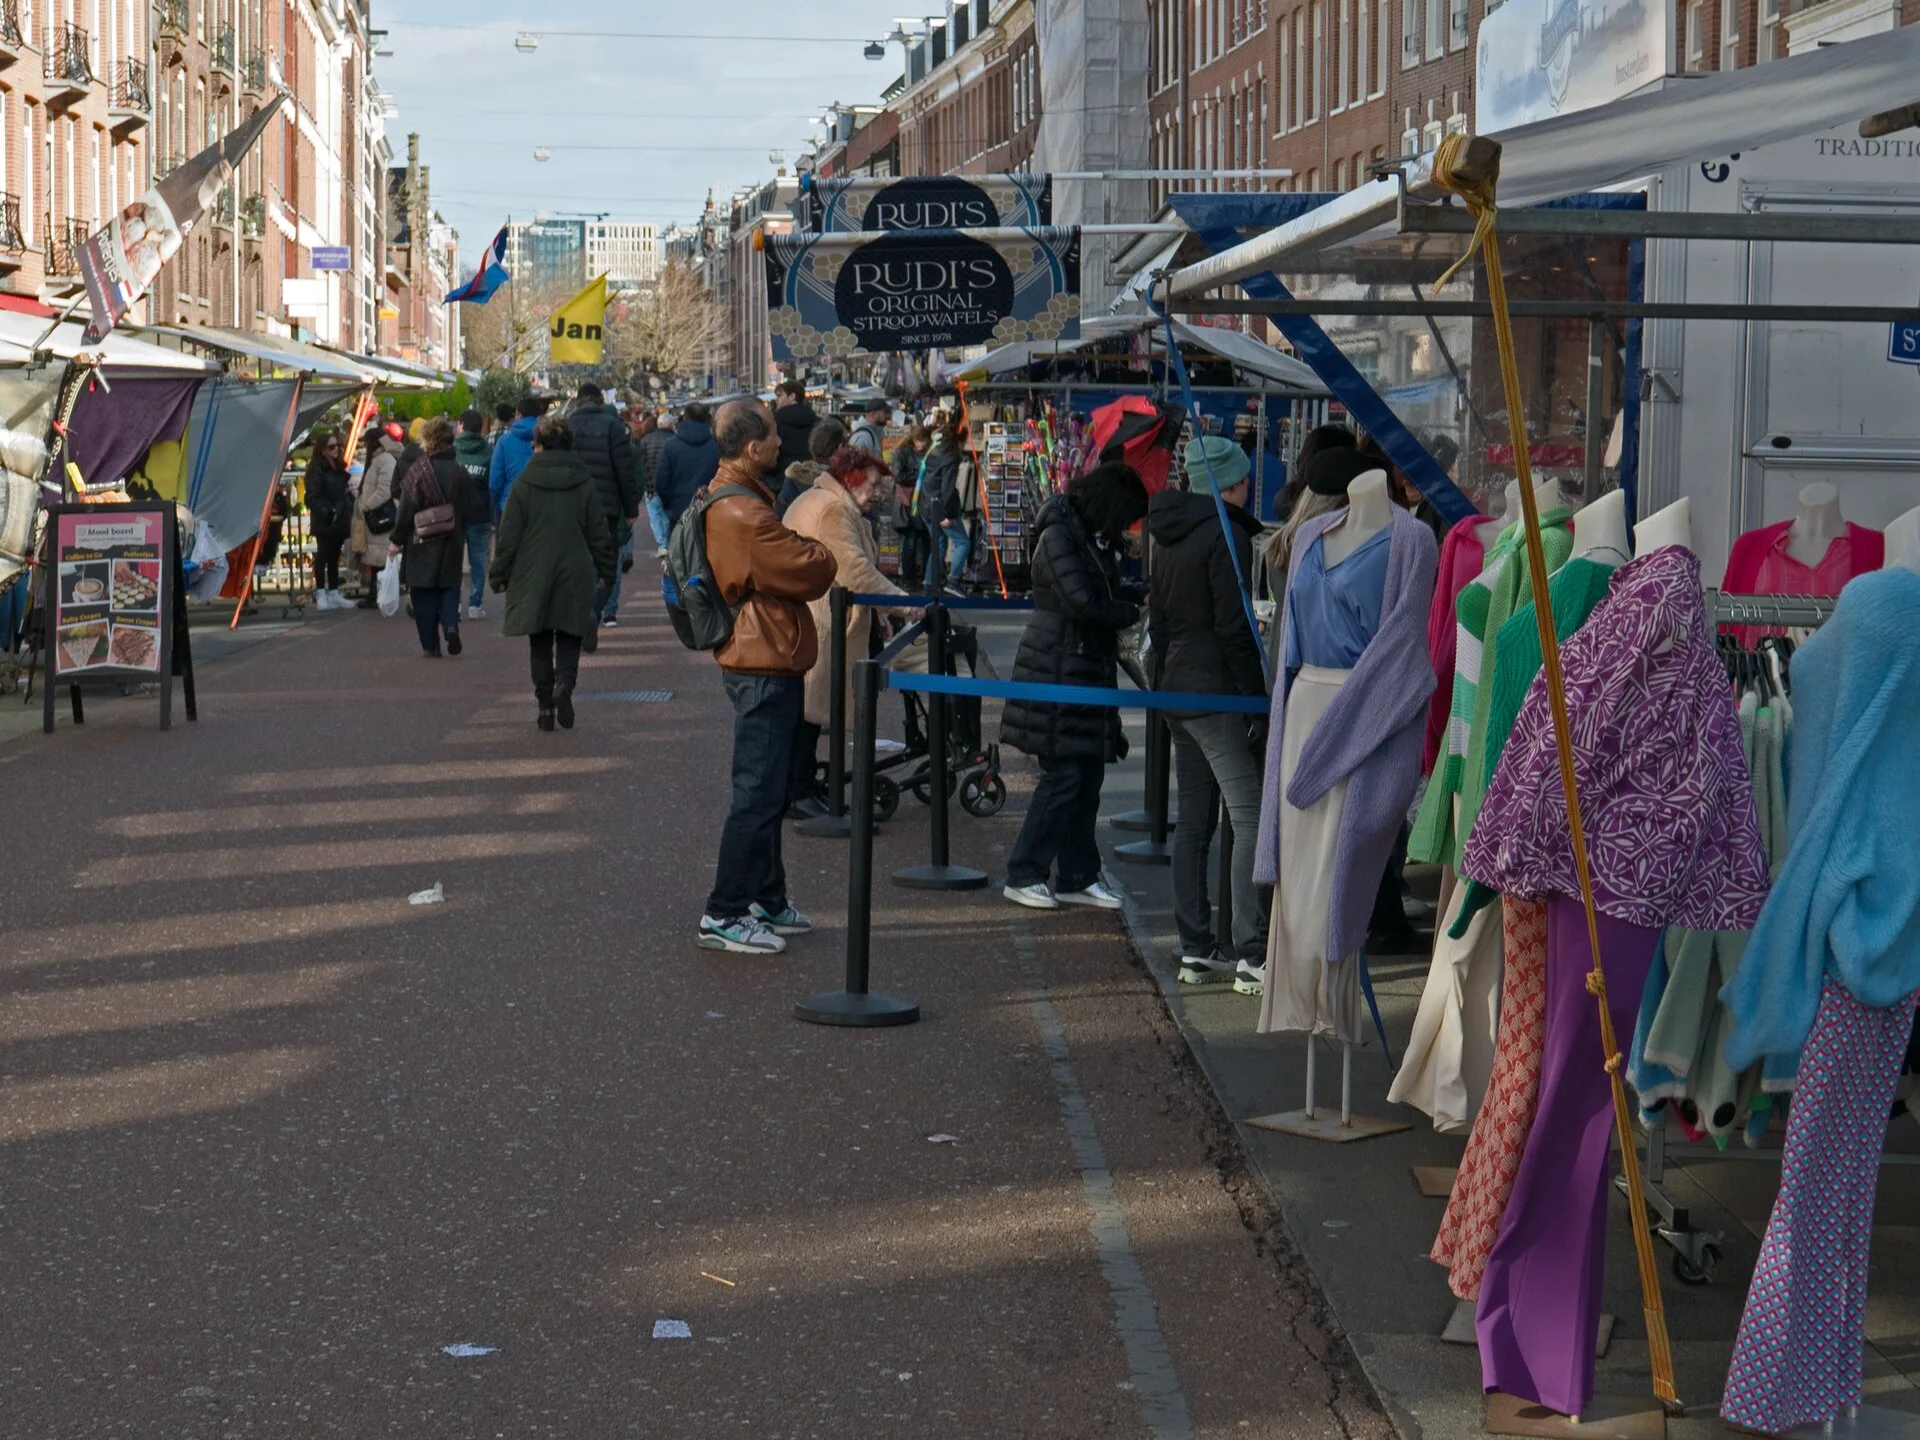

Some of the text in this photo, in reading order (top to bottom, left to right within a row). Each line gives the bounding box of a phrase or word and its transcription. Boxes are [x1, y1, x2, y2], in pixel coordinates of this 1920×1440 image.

[876, 201, 987, 231] RUDI'S
[853, 260, 996, 295] RUDI'S
[868, 292, 983, 314] ORIGINAL
[551, 317, 602, 341] Jan
[853, 310, 999, 332] STROOPWAFELS
[901, 333, 952, 345] SINCE 1978
[1903, 328, 1920, 353] S
[88, 527, 134, 536] Mood board
[65, 553, 85, 561] Coffee
